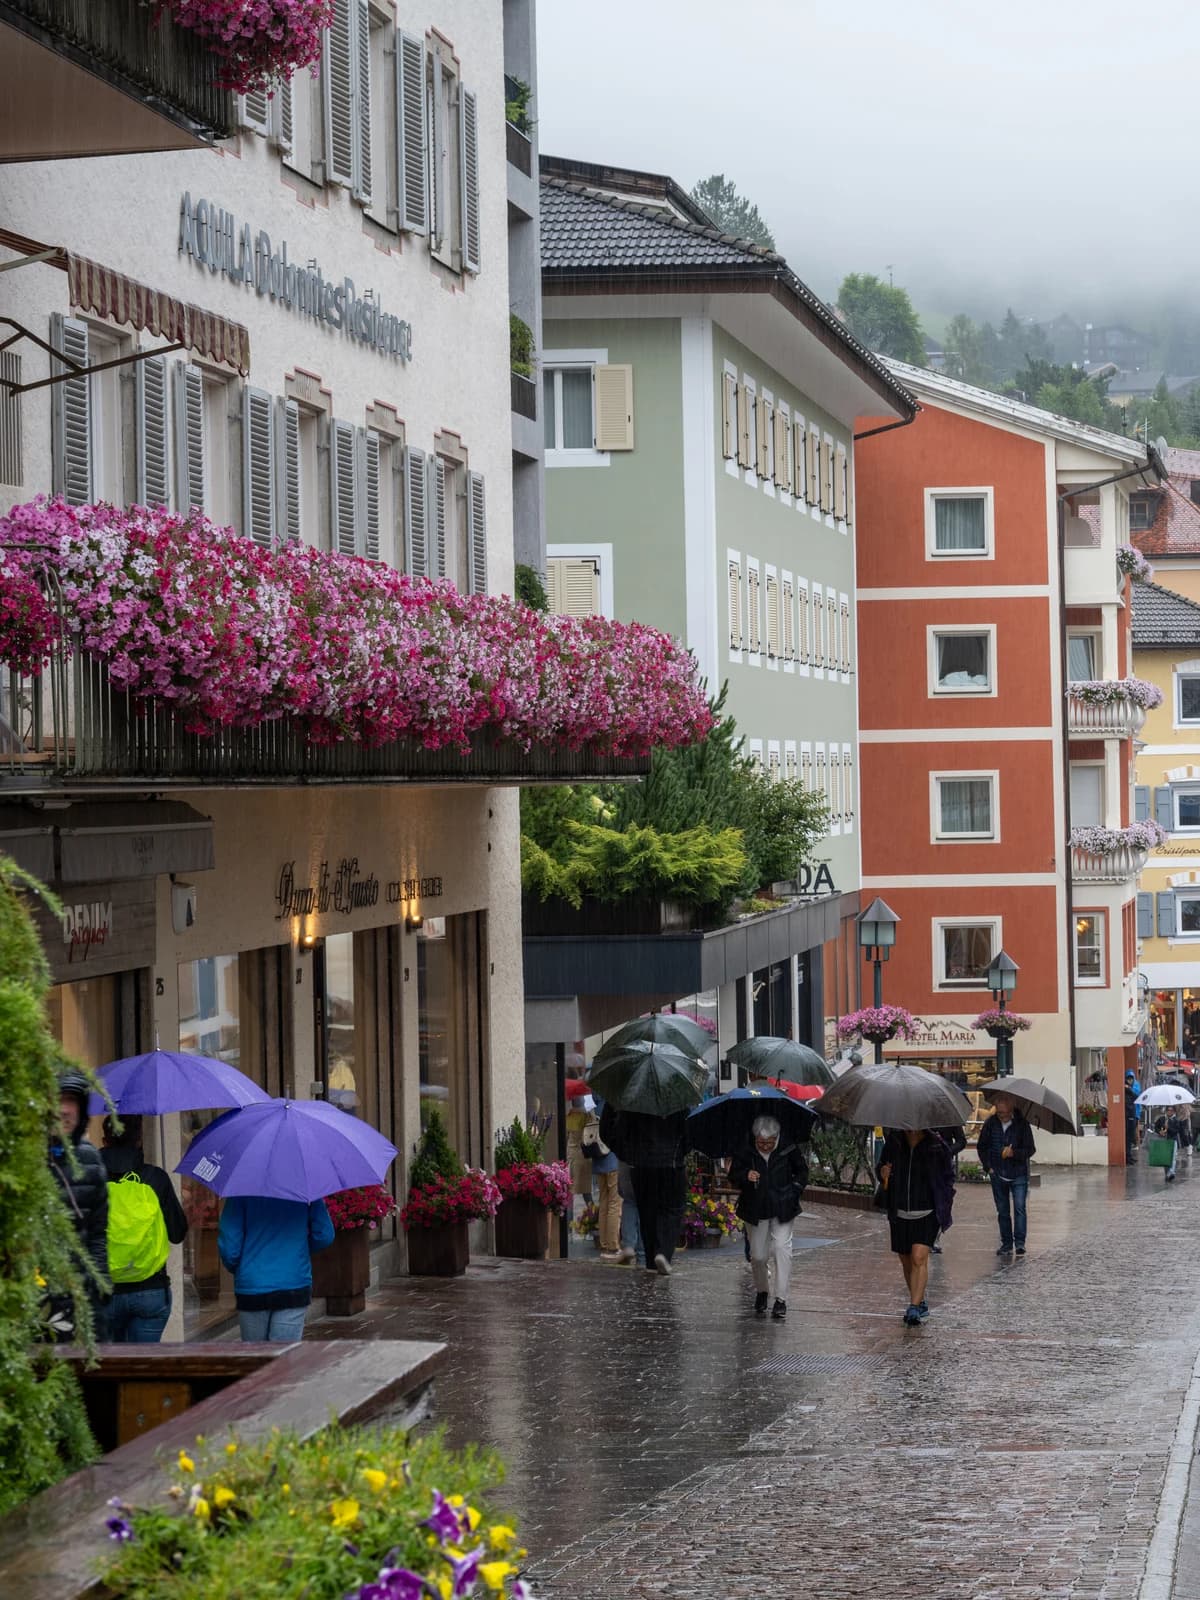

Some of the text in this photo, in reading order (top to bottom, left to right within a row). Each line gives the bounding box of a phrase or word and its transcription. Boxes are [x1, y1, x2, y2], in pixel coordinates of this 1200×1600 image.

[180, 190, 413, 362] AQUILA Dolomites Residence
[63, 901, 113, 944] DENIM
[941, 1030, 976, 1041] MARIA
